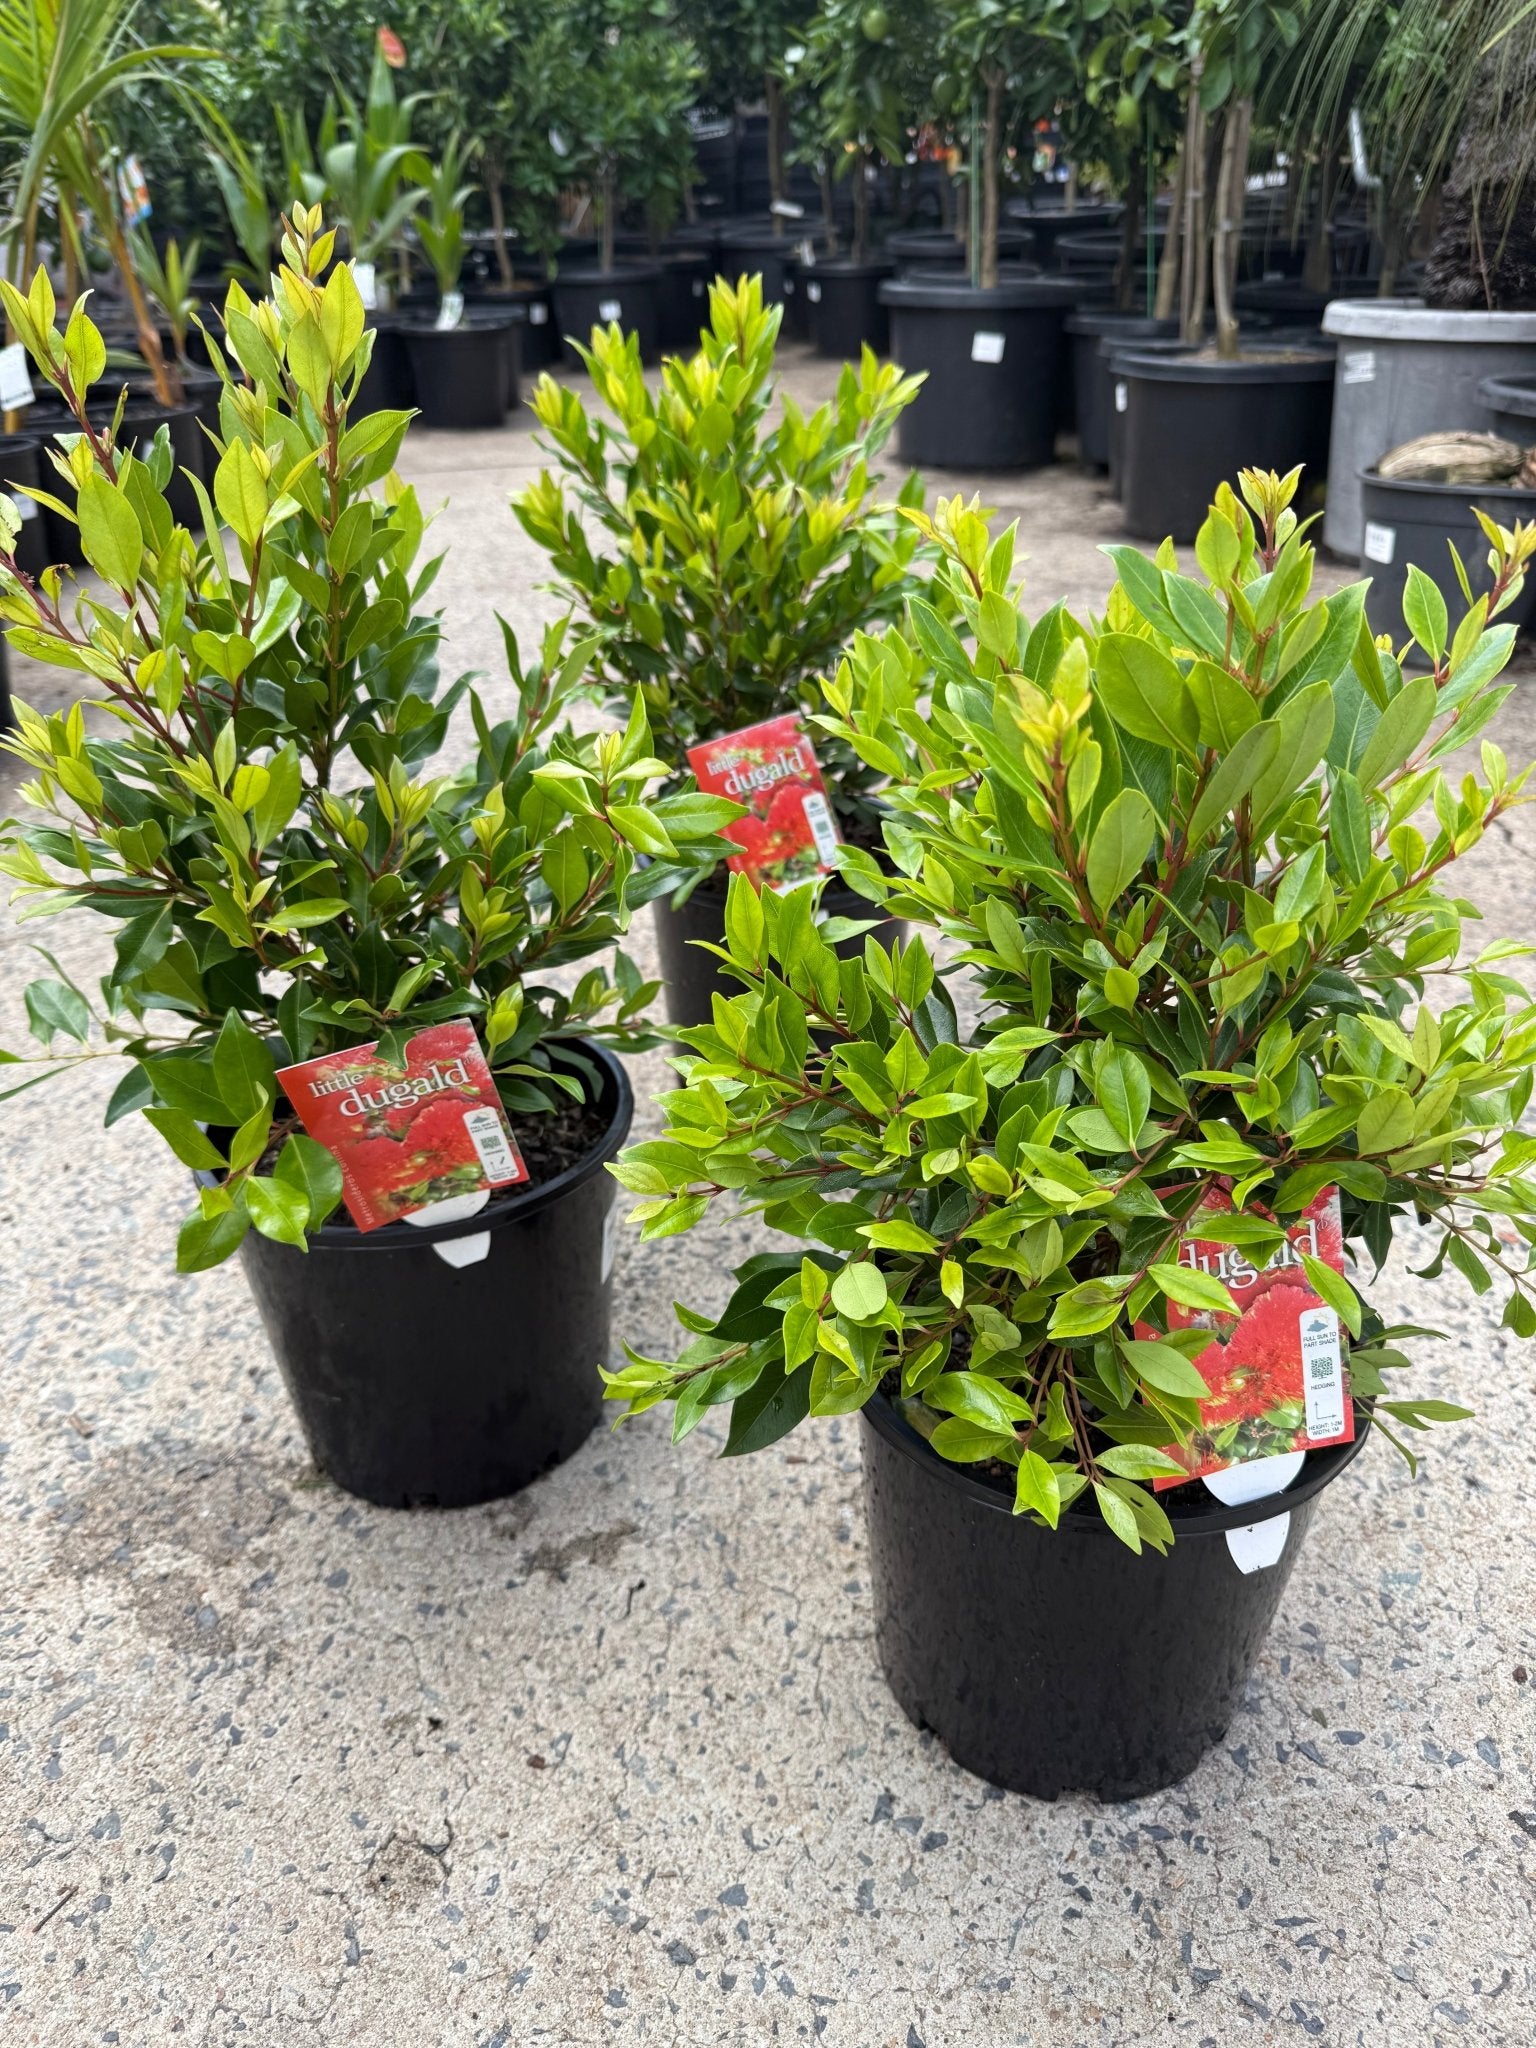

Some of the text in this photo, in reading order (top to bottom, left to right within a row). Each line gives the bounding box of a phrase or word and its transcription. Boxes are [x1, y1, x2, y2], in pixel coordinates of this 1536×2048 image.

[724, 747, 805, 795] dugald
[308, 1071, 365, 1098] little
[339, 1058, 472, 1117] dugald
[1303, 1335, 1316, 1343] FULL
[1318, 1337, 1336, 1346] SHADE
[1311, 1382, 1335, 1390] HEDGING
[1308, 1423, 1329, 1431] HEIGHT:
